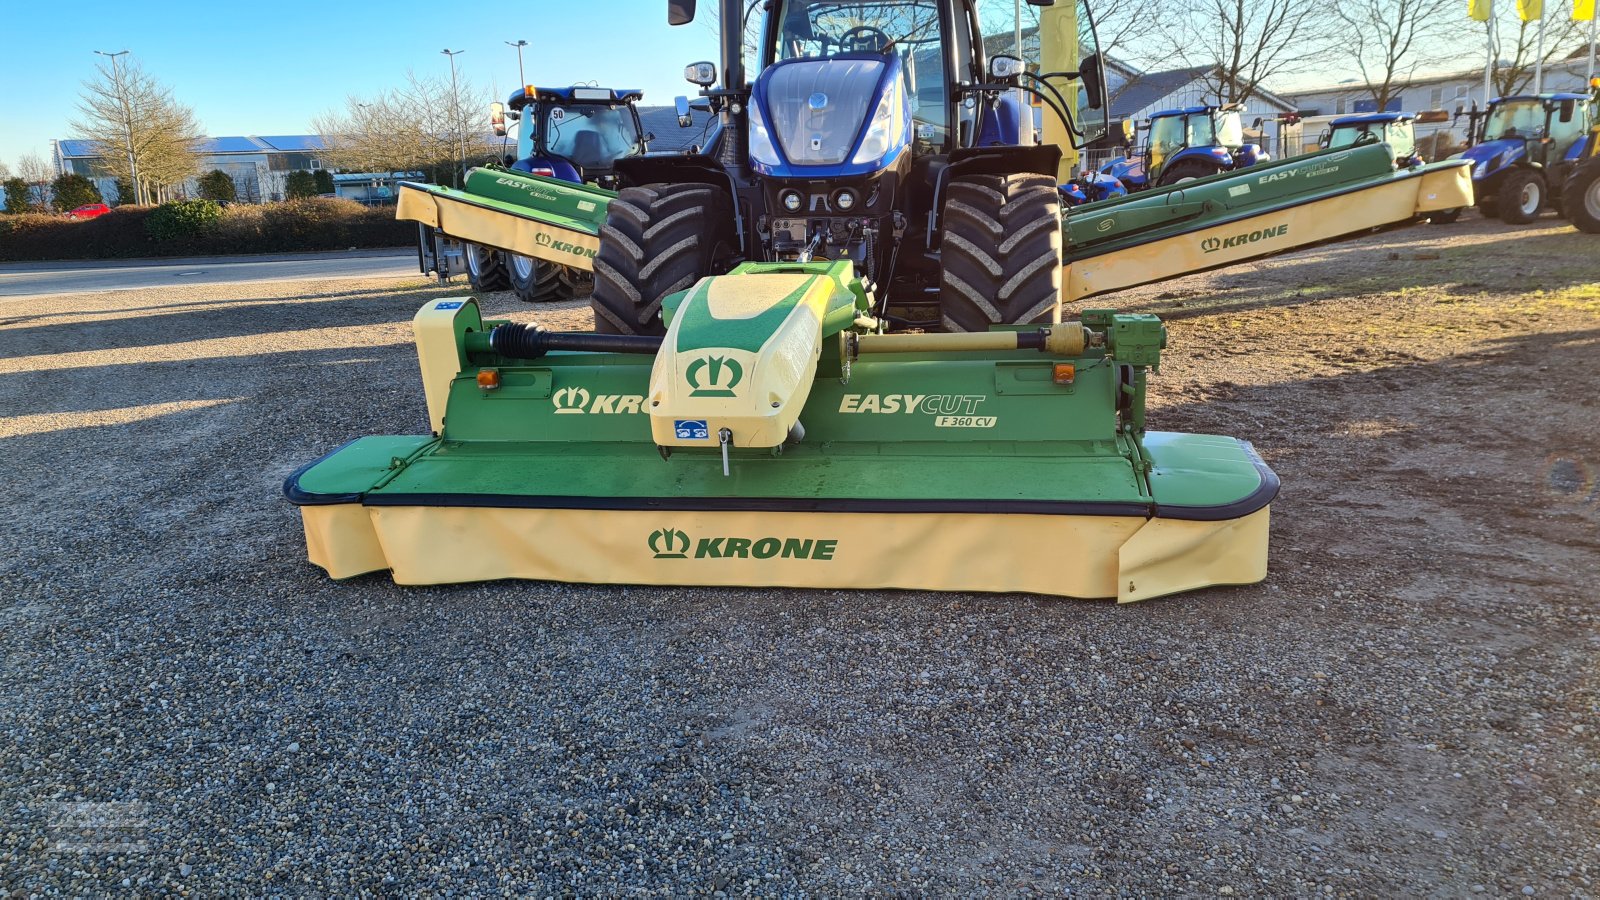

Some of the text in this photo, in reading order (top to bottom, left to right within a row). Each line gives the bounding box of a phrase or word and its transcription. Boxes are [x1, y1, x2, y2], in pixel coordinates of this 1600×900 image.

[553, 110, 563, 119] 50
[1223, 224, 1288, 249] KRONE
[838, 394, 986, 415] EASYCUT
[941, 417, 992, 427] F 360 CV
[694, 537, 838, 560] KRONE
